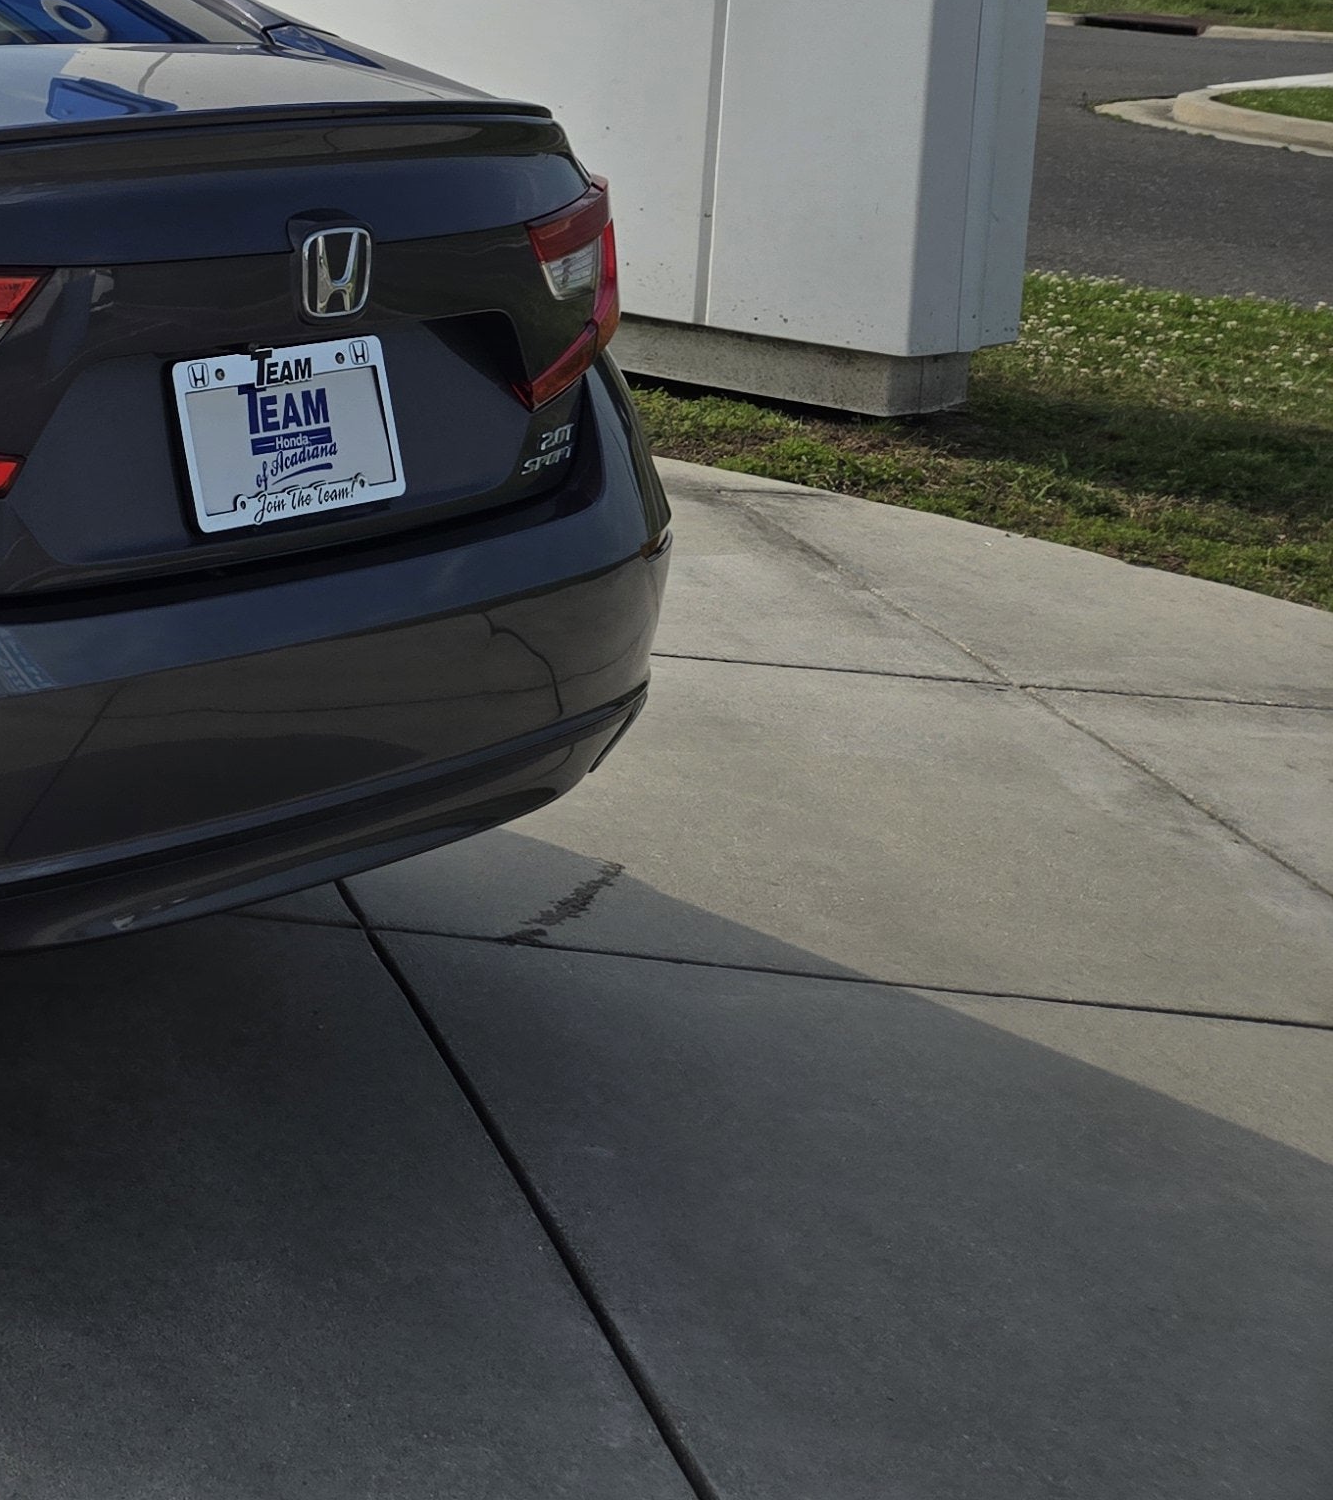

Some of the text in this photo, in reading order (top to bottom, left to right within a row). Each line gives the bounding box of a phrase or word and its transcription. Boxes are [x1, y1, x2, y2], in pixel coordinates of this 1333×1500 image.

[250, 349, 312, 387] TEAM
[238, 383, 330, 435] TEAM
[275, 432, 310, 450] Honda
[256, 441, 339, 492] of Acadiana
[253, 479, 357, 524] Join The Team!
